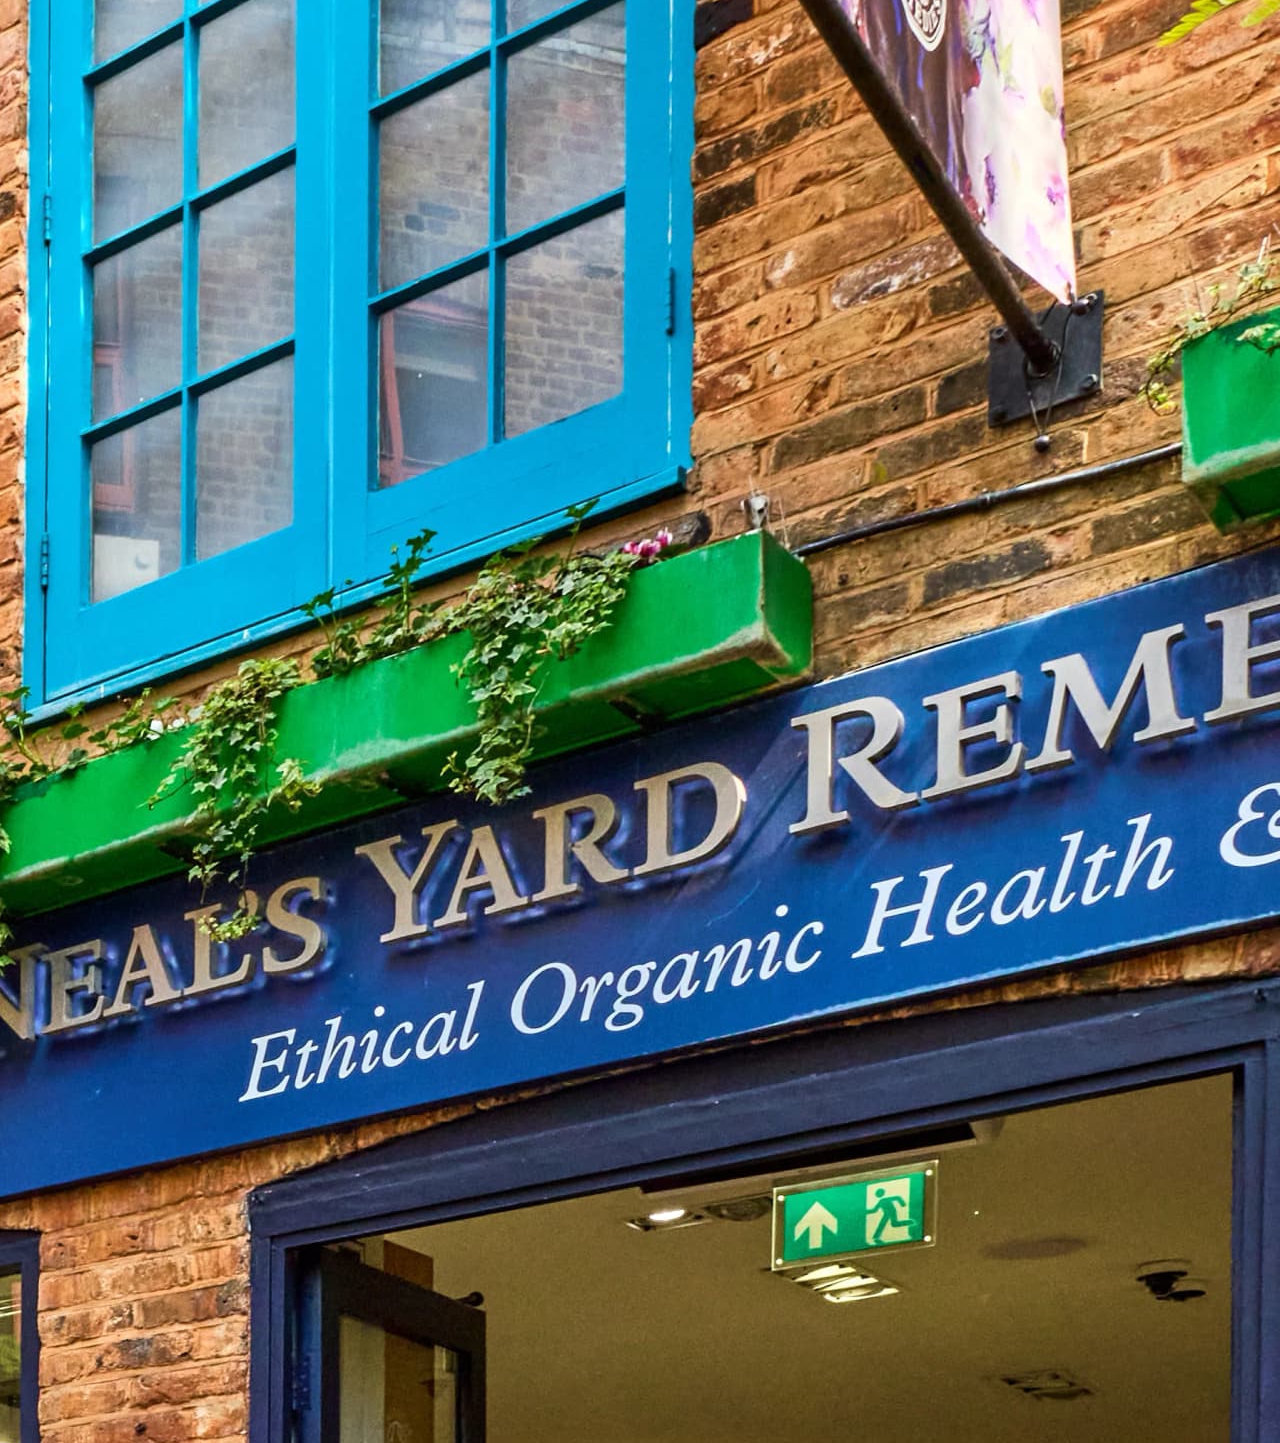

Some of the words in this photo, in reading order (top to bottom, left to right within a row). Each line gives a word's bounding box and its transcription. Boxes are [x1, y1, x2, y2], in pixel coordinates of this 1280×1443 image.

[239, 980, 485, 1103] Ethical
[510, 904, 825, 1032] Organic
[850, 813, 1175, 959] Health
[355, 761, 747, 944] YARD
